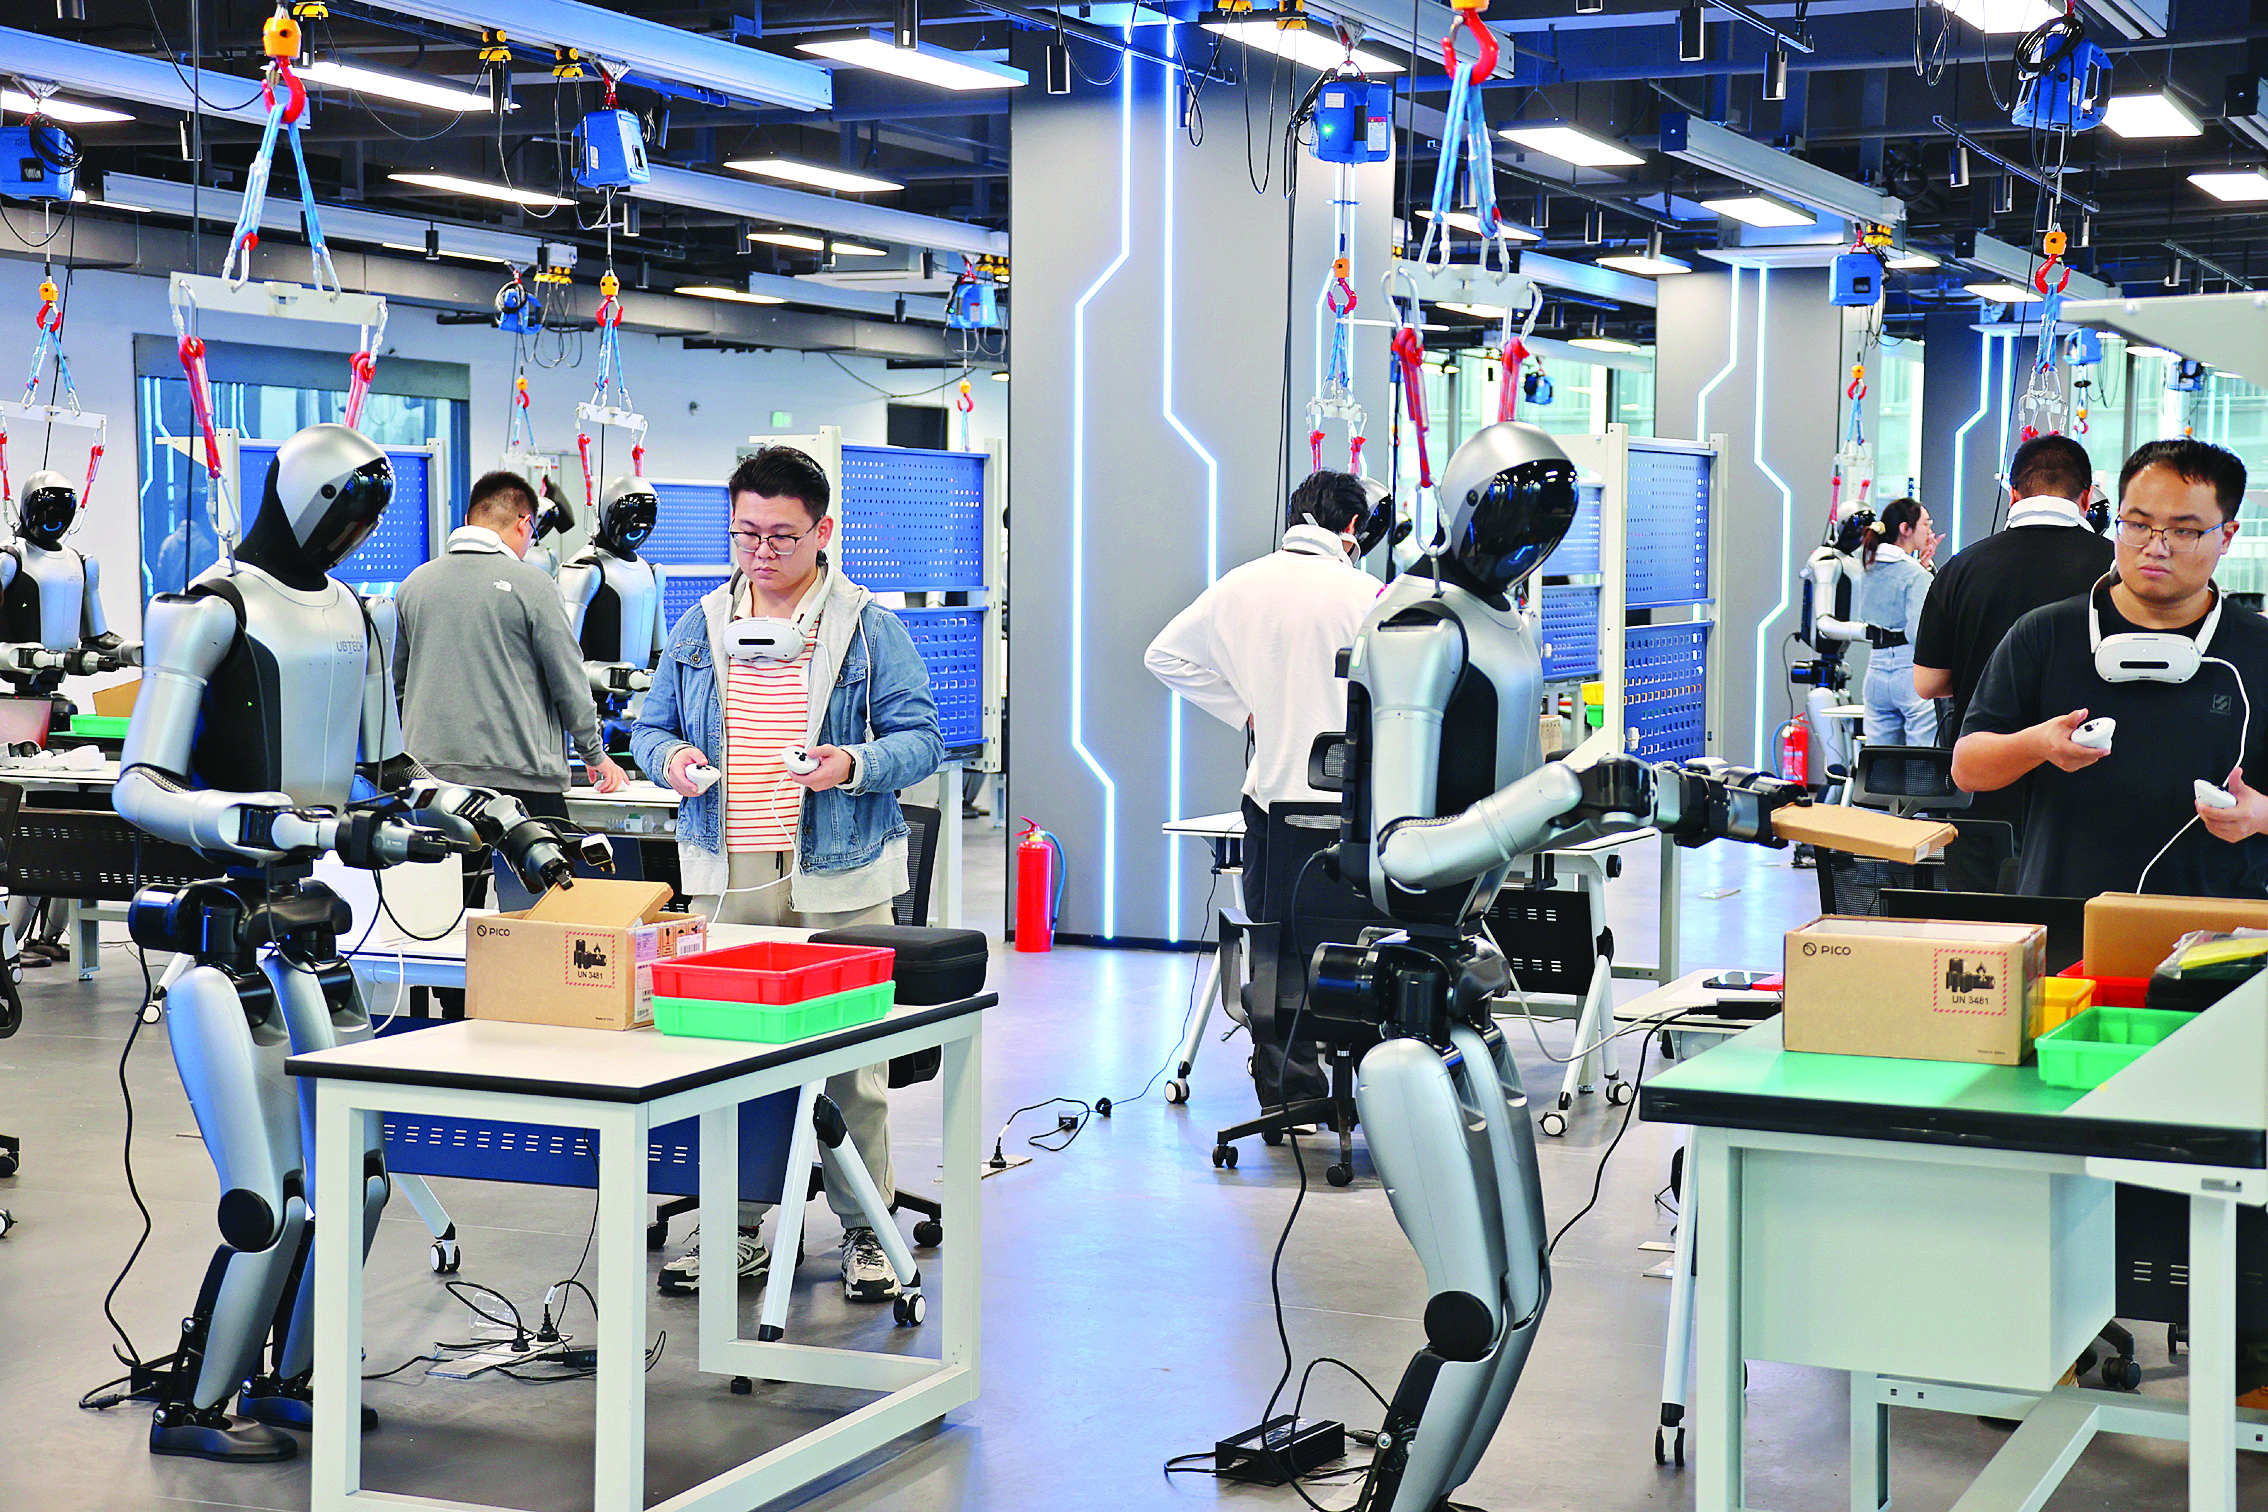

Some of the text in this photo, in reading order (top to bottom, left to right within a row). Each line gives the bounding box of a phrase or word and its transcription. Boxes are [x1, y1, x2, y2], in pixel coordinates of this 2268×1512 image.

[489, 927, 510, 937] PICO
[1821, 945, 1851, 956] PICO
[577, 970, 603, 980] UN 3481
[1952, 995, 1989, 1005] UN 3481
